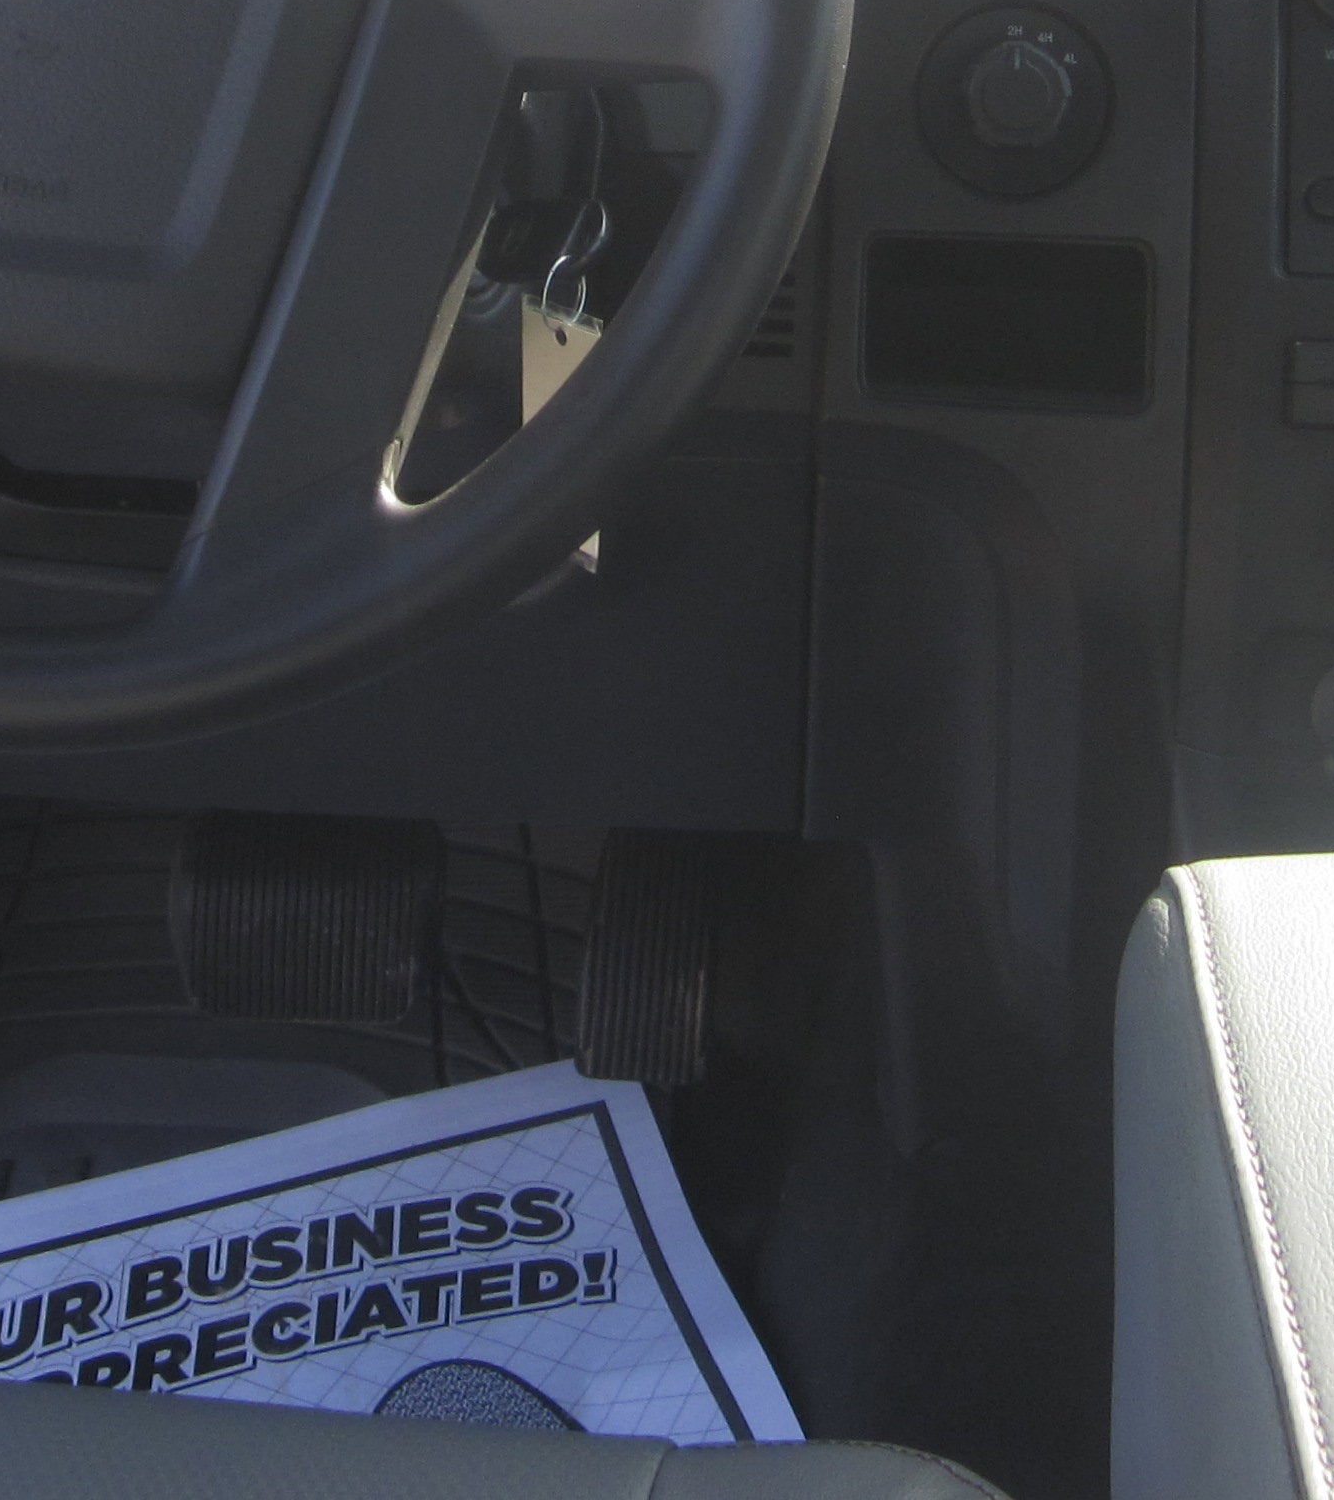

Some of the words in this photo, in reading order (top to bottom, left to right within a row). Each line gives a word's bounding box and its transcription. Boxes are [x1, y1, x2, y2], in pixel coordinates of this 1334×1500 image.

[1007, 24, 1023, 37] 2H
[32, 1248, 613, 1392] PRECIATED!
[123, 1185, 569, 1322] BUSINESS
